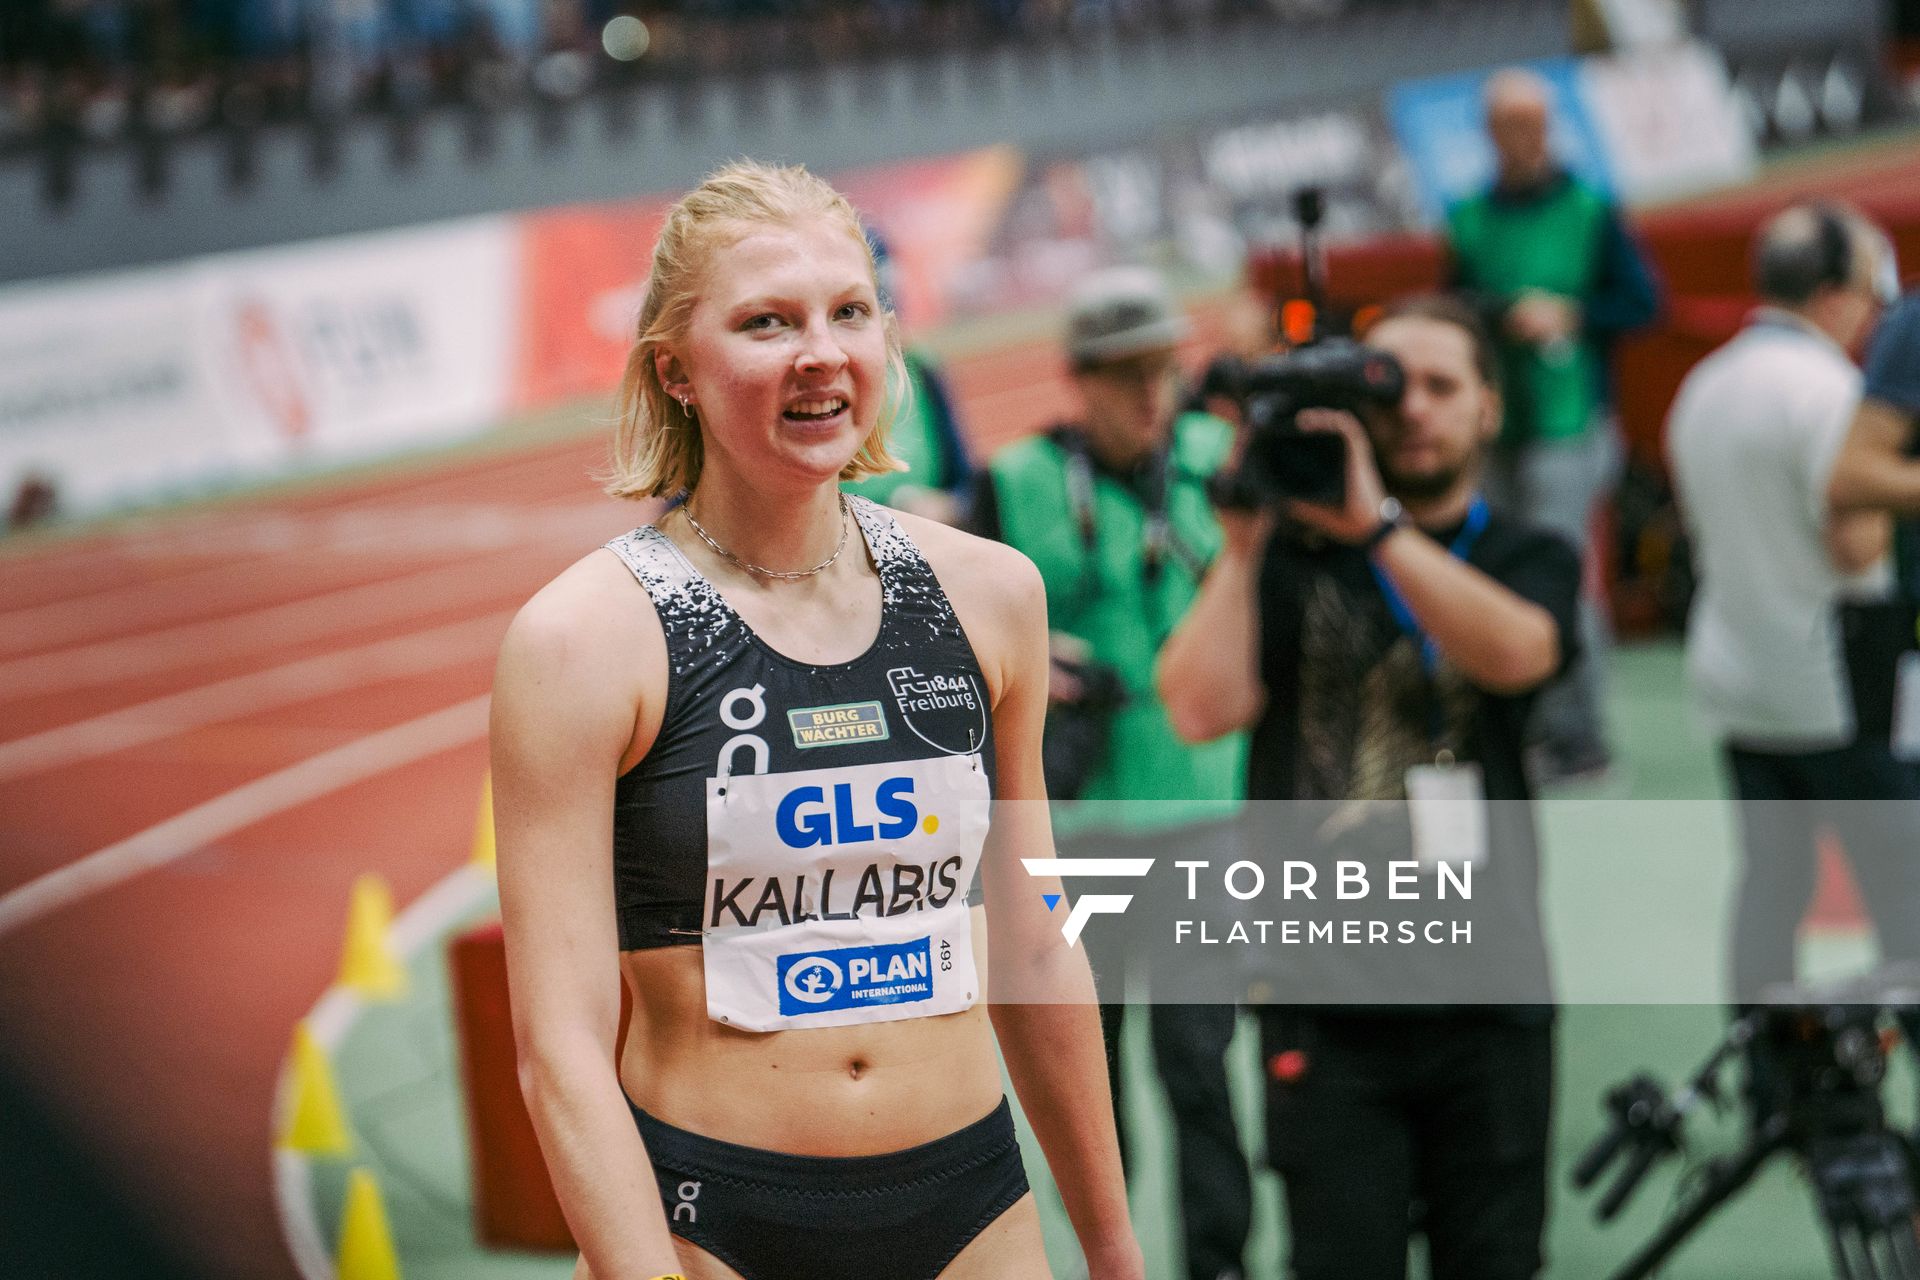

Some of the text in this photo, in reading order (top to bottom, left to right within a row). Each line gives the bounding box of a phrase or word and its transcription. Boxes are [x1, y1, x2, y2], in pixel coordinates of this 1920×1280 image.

[929, 675, 969, 692] 1844
[896, 690, 976, 714] Freiburg
[811, 709, 860, 725] BURG
[799, 723, 879, 743] WÄCHTER
[710, 855, 963, 928] KALLABIS
[939, 939, 953, 973] 493
[848, 951, 928, 986] PLAN
[850, 982, 929, 1000] INTERNATIONAL
